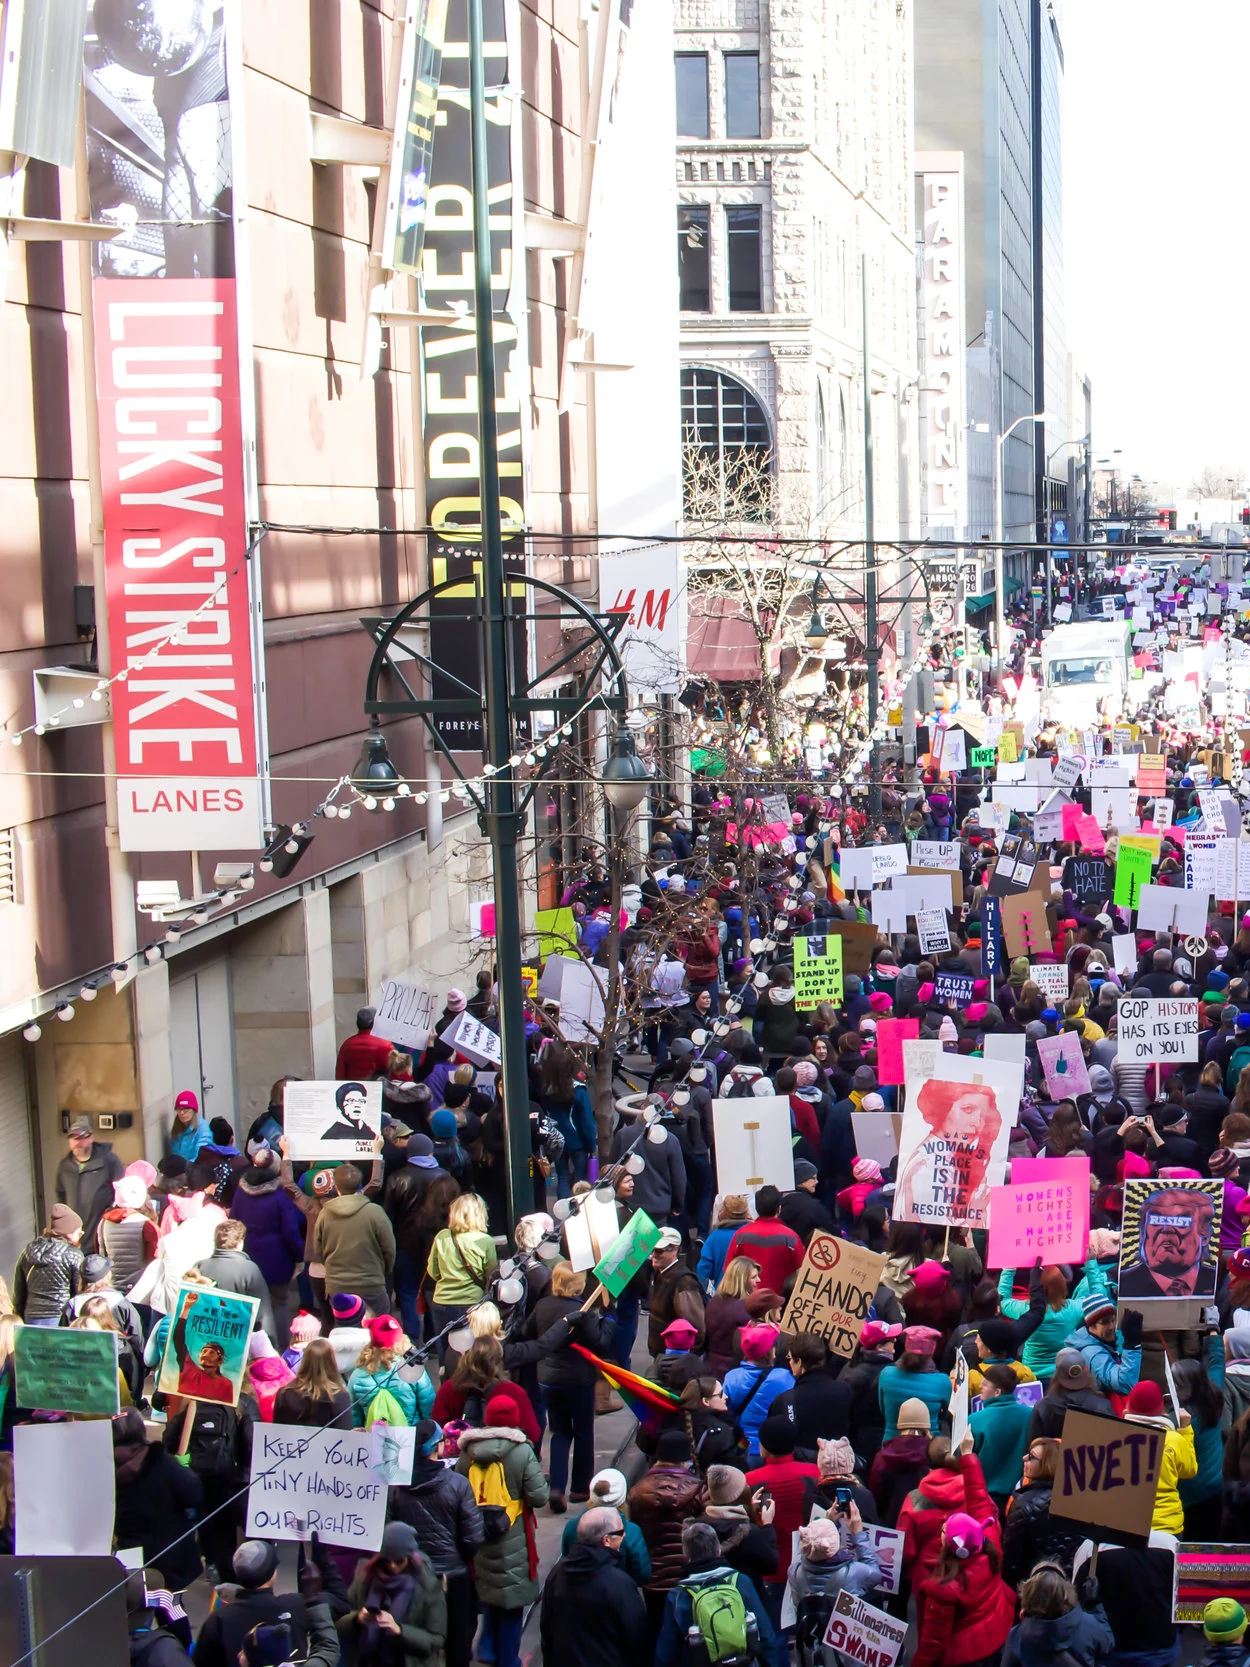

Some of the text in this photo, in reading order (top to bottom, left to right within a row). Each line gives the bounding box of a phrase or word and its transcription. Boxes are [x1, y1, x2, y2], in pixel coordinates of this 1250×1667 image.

[931, 181, 954, 507] PARAMOUNT
[108, 299, 243, 765] LUCKY STRIKE
[606, 588, 671, 632] H&M
[974, 749, 994, 763] NOPE
[131, 787, 245, 814] LANES
[916, 843, 954, 857] RISE UP
[1074, 861, 1105, 877] NO TO
[1074, 876, 1106, 895] HATE
[986, 902, 995, 970] HILLARY
[825, 958, 837, 966] UP
[1032, 965, 1060, 973] CLIMATE
[796, 968, 841, 979] STAND UP
[805, 978, 833, 988] DON'T
[936, 976, 974, 991] TRUST
[798, 987, 840, 997] GIVE UP
[935, 987, 973, 1001] WOMEN
[796, 1000, 812, 1009] THE
[1158, 1002, 1198, 1017] HISTORY
[1122, 1020, 1199, 1040] HAS ITS EYES
[1136, 1041, 1186, 1057] ON YOU!
[924, 1141, 986, 1160] WOMAN'S
[934, 1155, 971, 1169] PLACE
[932, 1170, 970, 1187] IS IN
[931, 1186, 968, 1205] THE
[1016, 1186, 1073, 1202] WOMENS
[911, 1203, 983, 1220] RESISTANCE
[1017, 1197, 1073, 1215] RIGHTS
[1047, 1210, 1072, 1222] ARE
[1149, 1214, 1192, 1227] RESIST
[1026, 1221, 1072, 1236] HUMAN
[1016, 1234, 1072, 1248] RIGHTS
[800, 1267, 874, 1320] HANDS
[793, 1297, 824, 1315] OFF
[191, 1314, 245, 1340] RESILIENT
[831, 1312, 854, 1327] OUR
[786, 1310, 858, 1354] RIGHTS
[264, 1435, 371, 1468] KEEP YOUR
[1063, 1433, 1160, 1497] NYET!
[256, 1470, 381, 1501] TINY HANDS OFF
[254, 1510, 298, 1531] OUR
[835, 1588, 905, 1643] Billionaires
[826, 1620, 895, 1667] SWAMP
